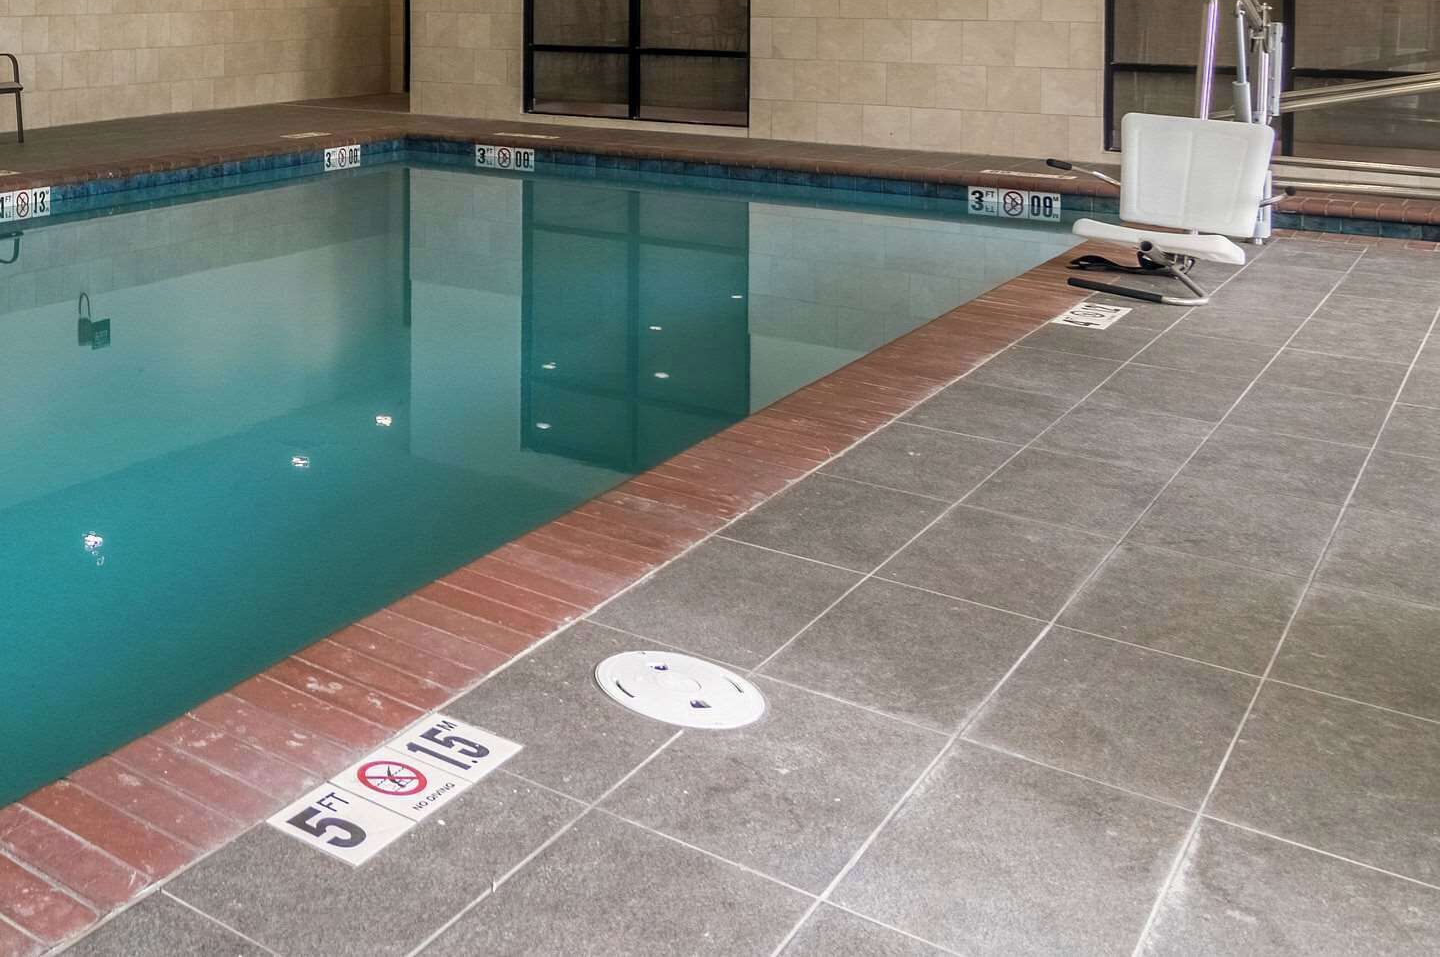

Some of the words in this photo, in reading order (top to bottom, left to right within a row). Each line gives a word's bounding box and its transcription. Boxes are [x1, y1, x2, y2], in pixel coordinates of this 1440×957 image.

[985, 190, 995, 198] FT
[436, 719, 457, 732] M
[406, 727, 490, 771] 1.5
[316, 791, 350, 813] FT
[412, 800, 428, 811] NO
[286, 805, 367, 849] 5
